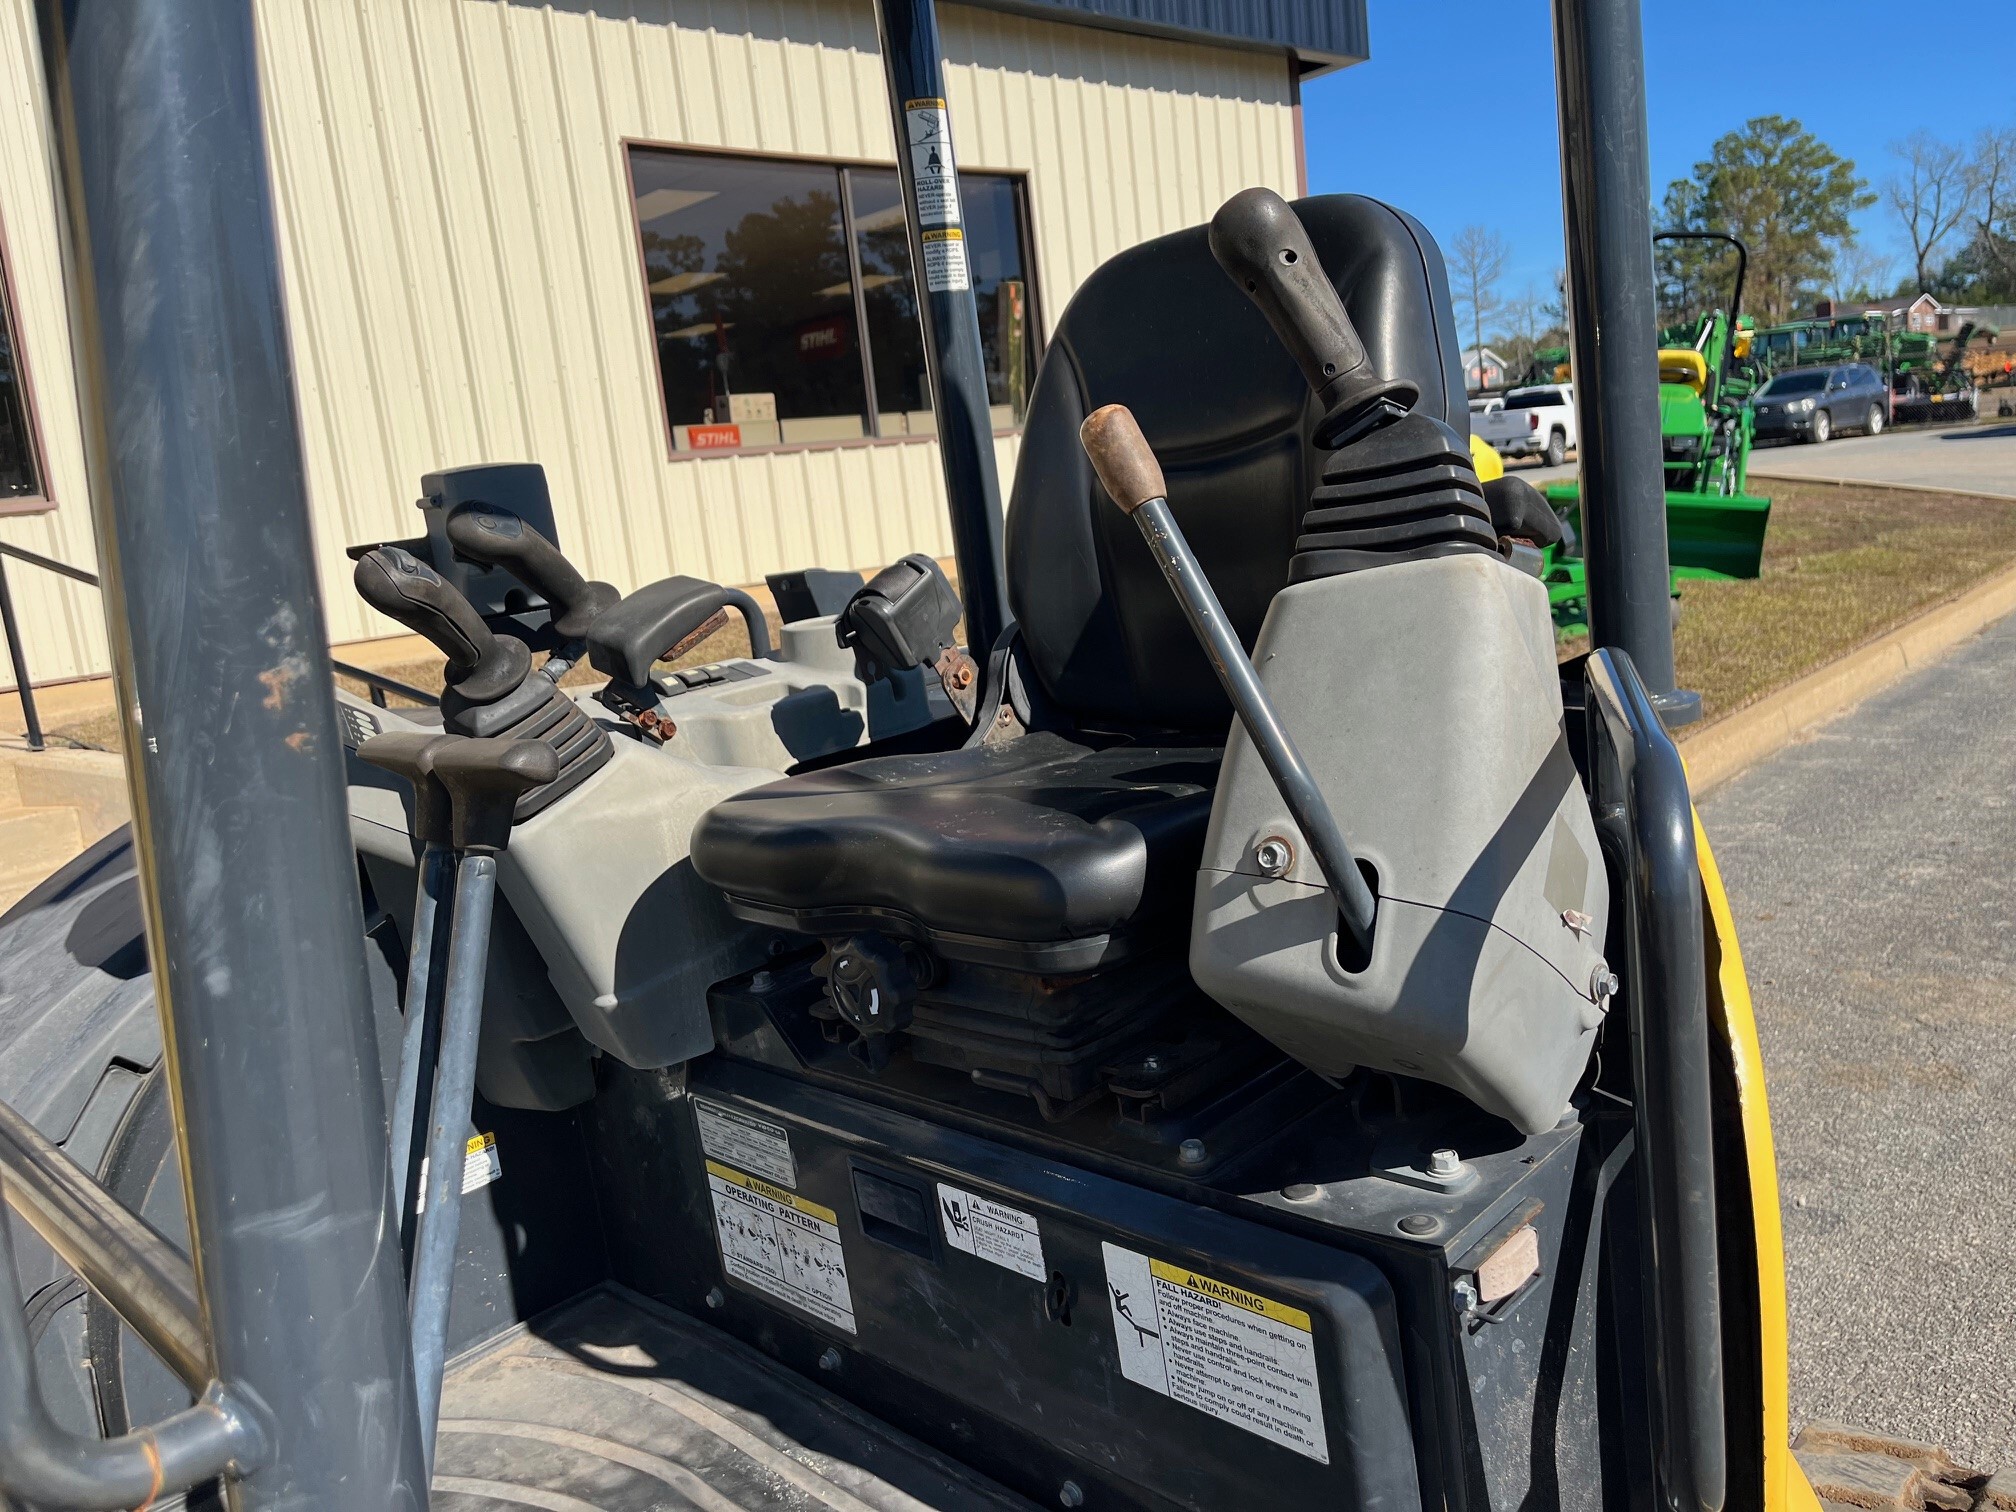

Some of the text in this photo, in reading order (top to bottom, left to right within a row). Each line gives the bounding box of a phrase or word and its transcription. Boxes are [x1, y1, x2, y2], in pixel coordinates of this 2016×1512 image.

[800, 328, 837, 350] STIHL
[696, 432, 738, 446] STIHL
[466, 1136, 491, 1151] NING
[724, 1183, 821, 1233] OPERATING PATTERN
[753, 1180, 793, 1205] WARNING
[971, 1215, 993, 1229] CRUSH
[994, 1223, 1024, 1242] HAZARD!
[986, 1204, 1023, 1225] WARNING
[810, 1286, 833, 1302] OPTION
[1156, 1279, 1221, 1310] FALL HAZARD!
[1199, 1278, 1265, 1312] WARNING
[1157, 1289, 1307, 1350] Follow proper procedures when getting on
[1158, 1297, 1214, 1324] and off machine.
[1166, 1309, 1241, 1342] Always face machine.
[1168, 1317, 1192, 1333] Always
[1193, 1328, 1206, 1338] use
[1207, 1332, 1228, 1347] steps
[1228, 1340, 1242, 1351] and
[1169, 1326, 1312, 1387] Always maintain three-point contact with
[1170, 1334, 1239, 1367] steps and handrails.
[1173, 1350, 1205, 1369] handrails.
[1171, 1342, 1298, 1399] Never use control and lock levers as
[1175, 1367, 1206, 1386] machine.
[1172, 1390, 1220, 1417] serious injury.
[1174, 1359, 1194, 1373] Never
[1195, 1368, 1222, 1386] attempt
[1222, 1379, 1230, 1388] to
[1231, 1383, 1247, 1396] get
[1247, 1390, 1255, 1398] on
[1255, 1393, 1263, 1402] or
[1264, 1396, 1275, 1407] off
[1282, 1404, 1311, 1423] moving
[1176, 1376, 1305, 1436] Never jump on or off of any machine.
[1171, 1381, 1314, 1448] Failure to comply could result in death or
